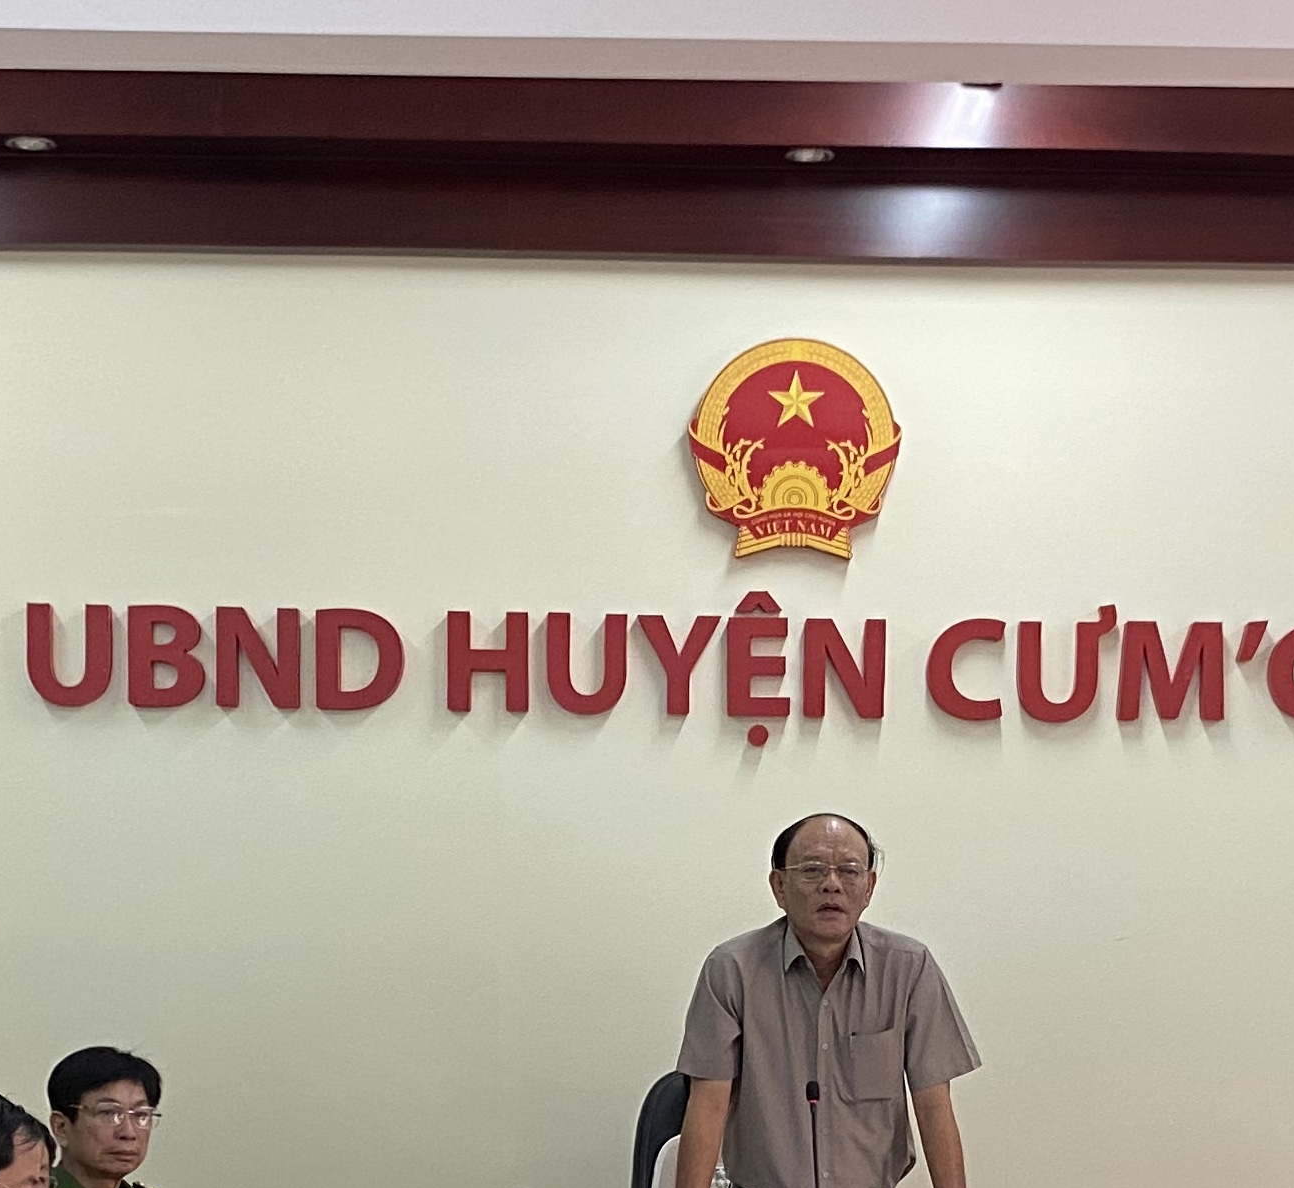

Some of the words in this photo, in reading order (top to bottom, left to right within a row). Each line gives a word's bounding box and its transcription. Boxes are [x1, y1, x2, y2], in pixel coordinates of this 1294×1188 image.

[796, 519, 832, 538] NAM
[26, 603, 405, 710] UBND
[446, 591, 886, 747] HUYỆN
